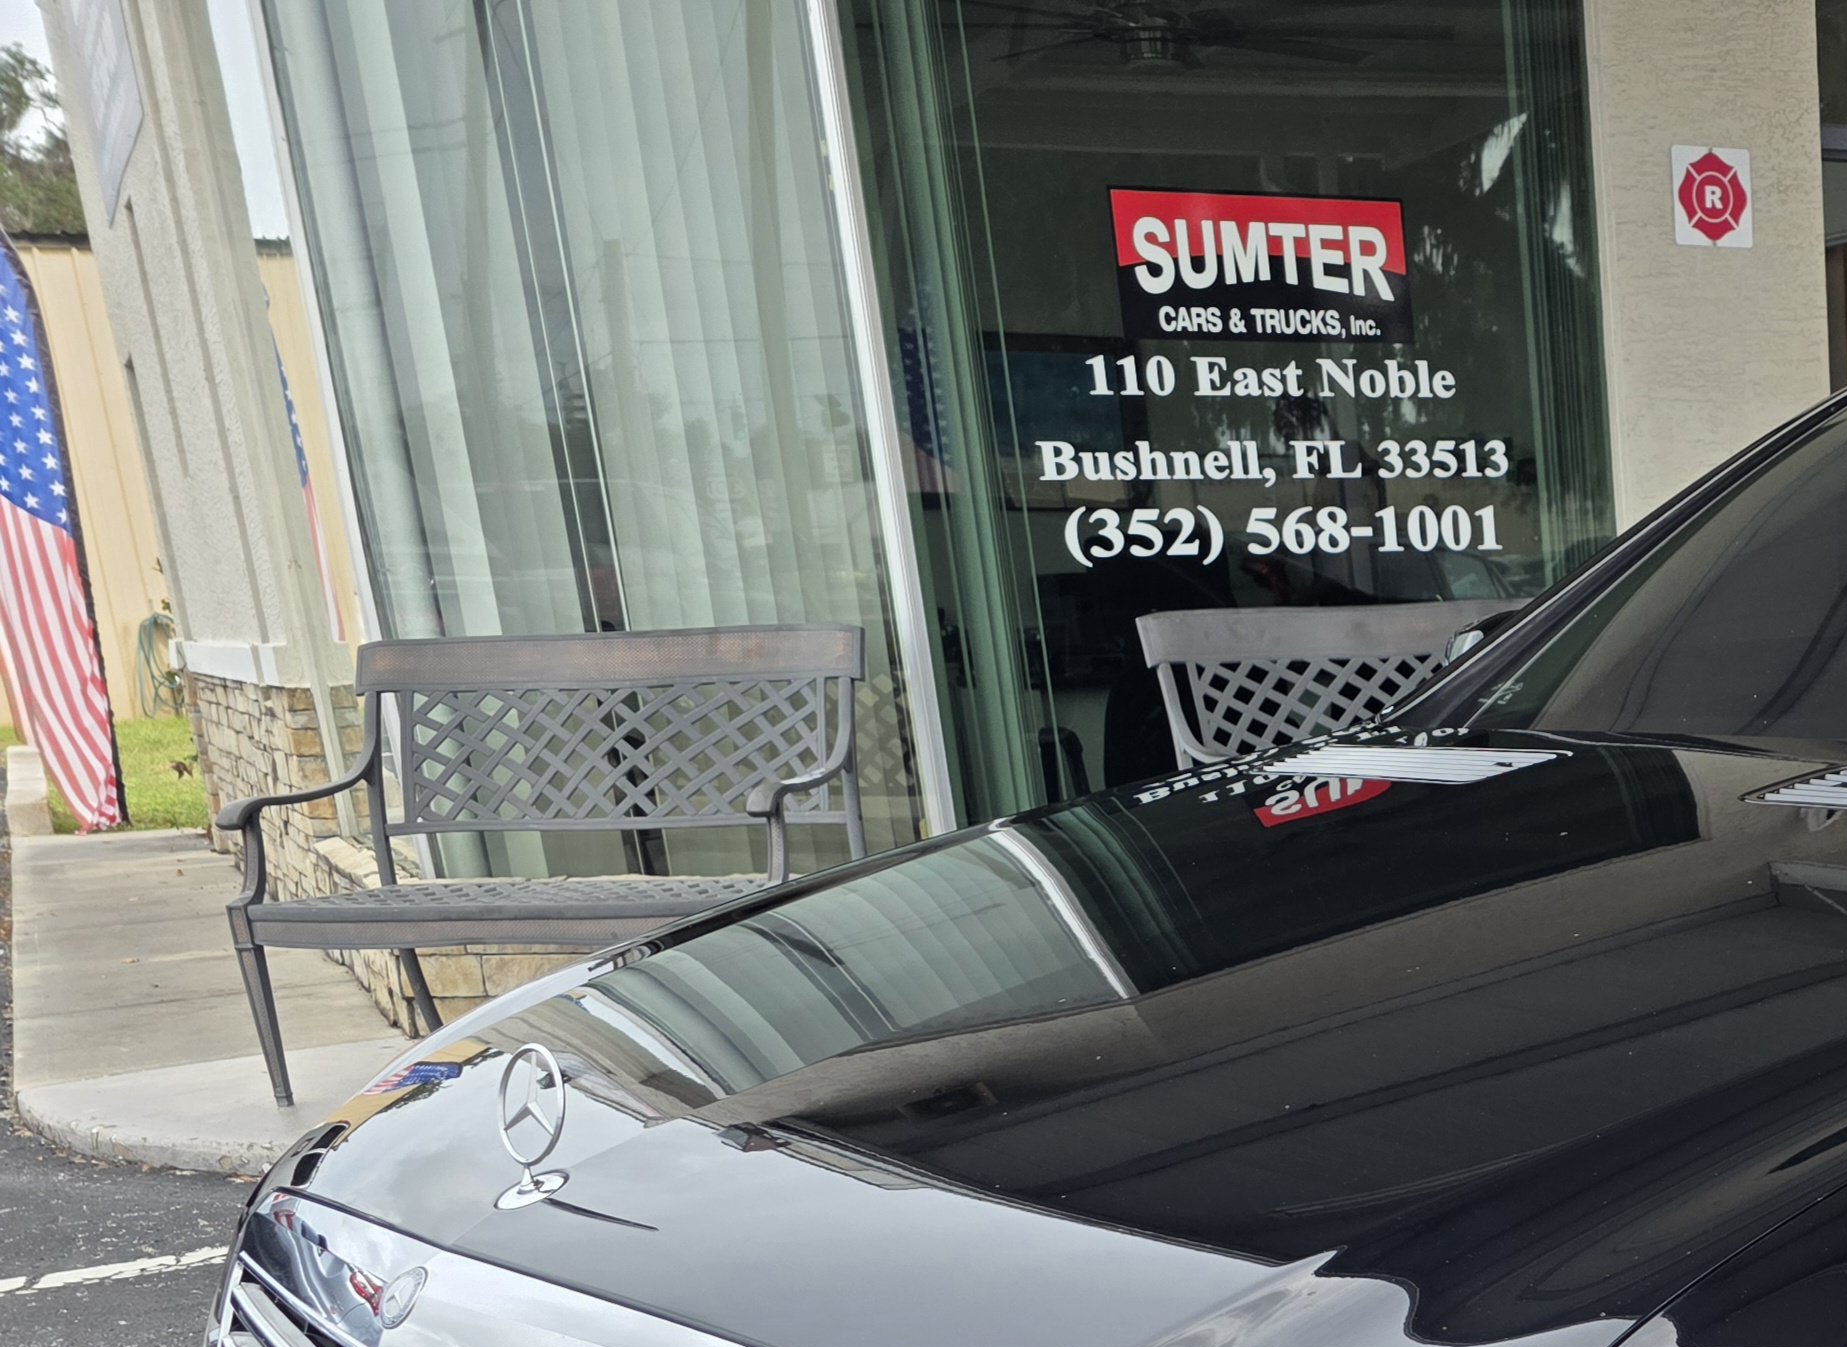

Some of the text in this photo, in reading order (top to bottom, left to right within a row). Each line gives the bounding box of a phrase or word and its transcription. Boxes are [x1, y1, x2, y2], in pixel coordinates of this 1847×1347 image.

[1704, 185, 1723, 209] R
[1132, 216, 1395, 302] SUMTER
[1158, 305, 1382, 339] CARS & TRUCKS, Inc.
[1085, 354, 1456, 399] 110 East Noble
[1034, 439, 1509, 488] Bushnell, FL 33513
[1064, 504, 1503, 568] (352) 568-1001
